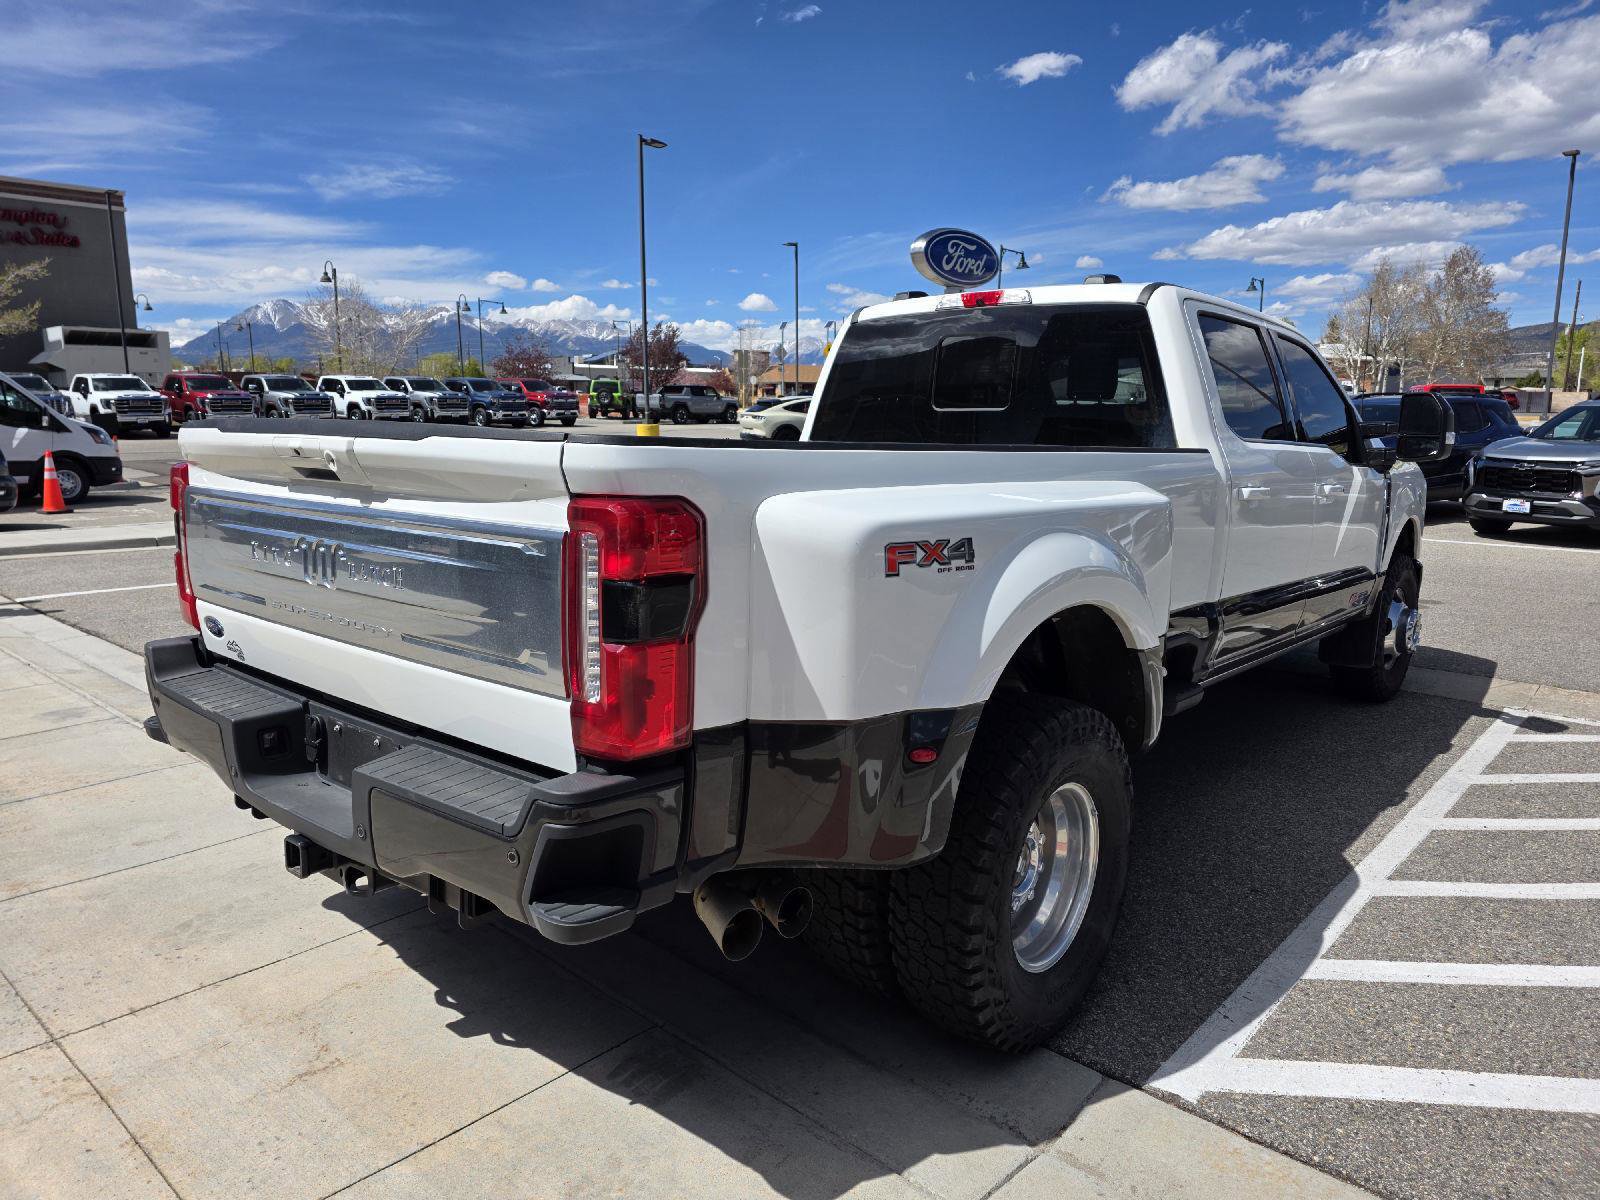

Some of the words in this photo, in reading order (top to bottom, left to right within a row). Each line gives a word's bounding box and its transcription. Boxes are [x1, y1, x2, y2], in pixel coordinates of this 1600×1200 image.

[942, 239, 987, 276] Ford
[885, 537, 975, 578] FX4
[937, 566, 953, 574] OFF
[955, 564, 975, 572] ROAD
